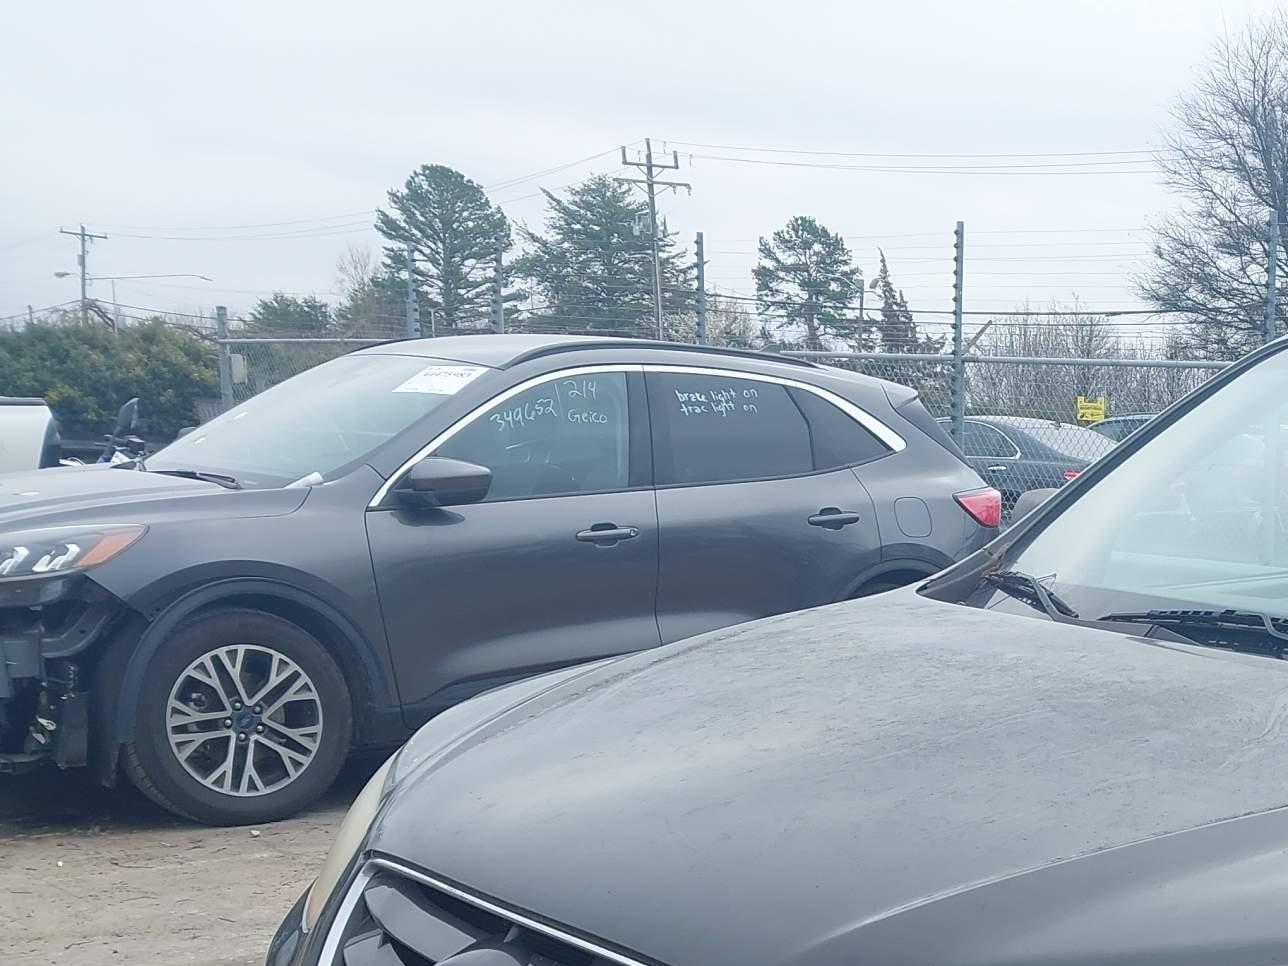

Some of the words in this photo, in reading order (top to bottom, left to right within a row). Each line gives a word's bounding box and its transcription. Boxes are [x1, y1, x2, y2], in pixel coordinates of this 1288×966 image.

[563, 380, 596, 400] 214
[710, 388, 736, 405] light
[743, 389, 758, 399] on
[489, 398, 558, 431] 349652
[567, 408, 608, 424] Geico
[680, 403, 709, 416] trac
[710, 401, 736, 417] light
[743, 404, 758, 414] on
